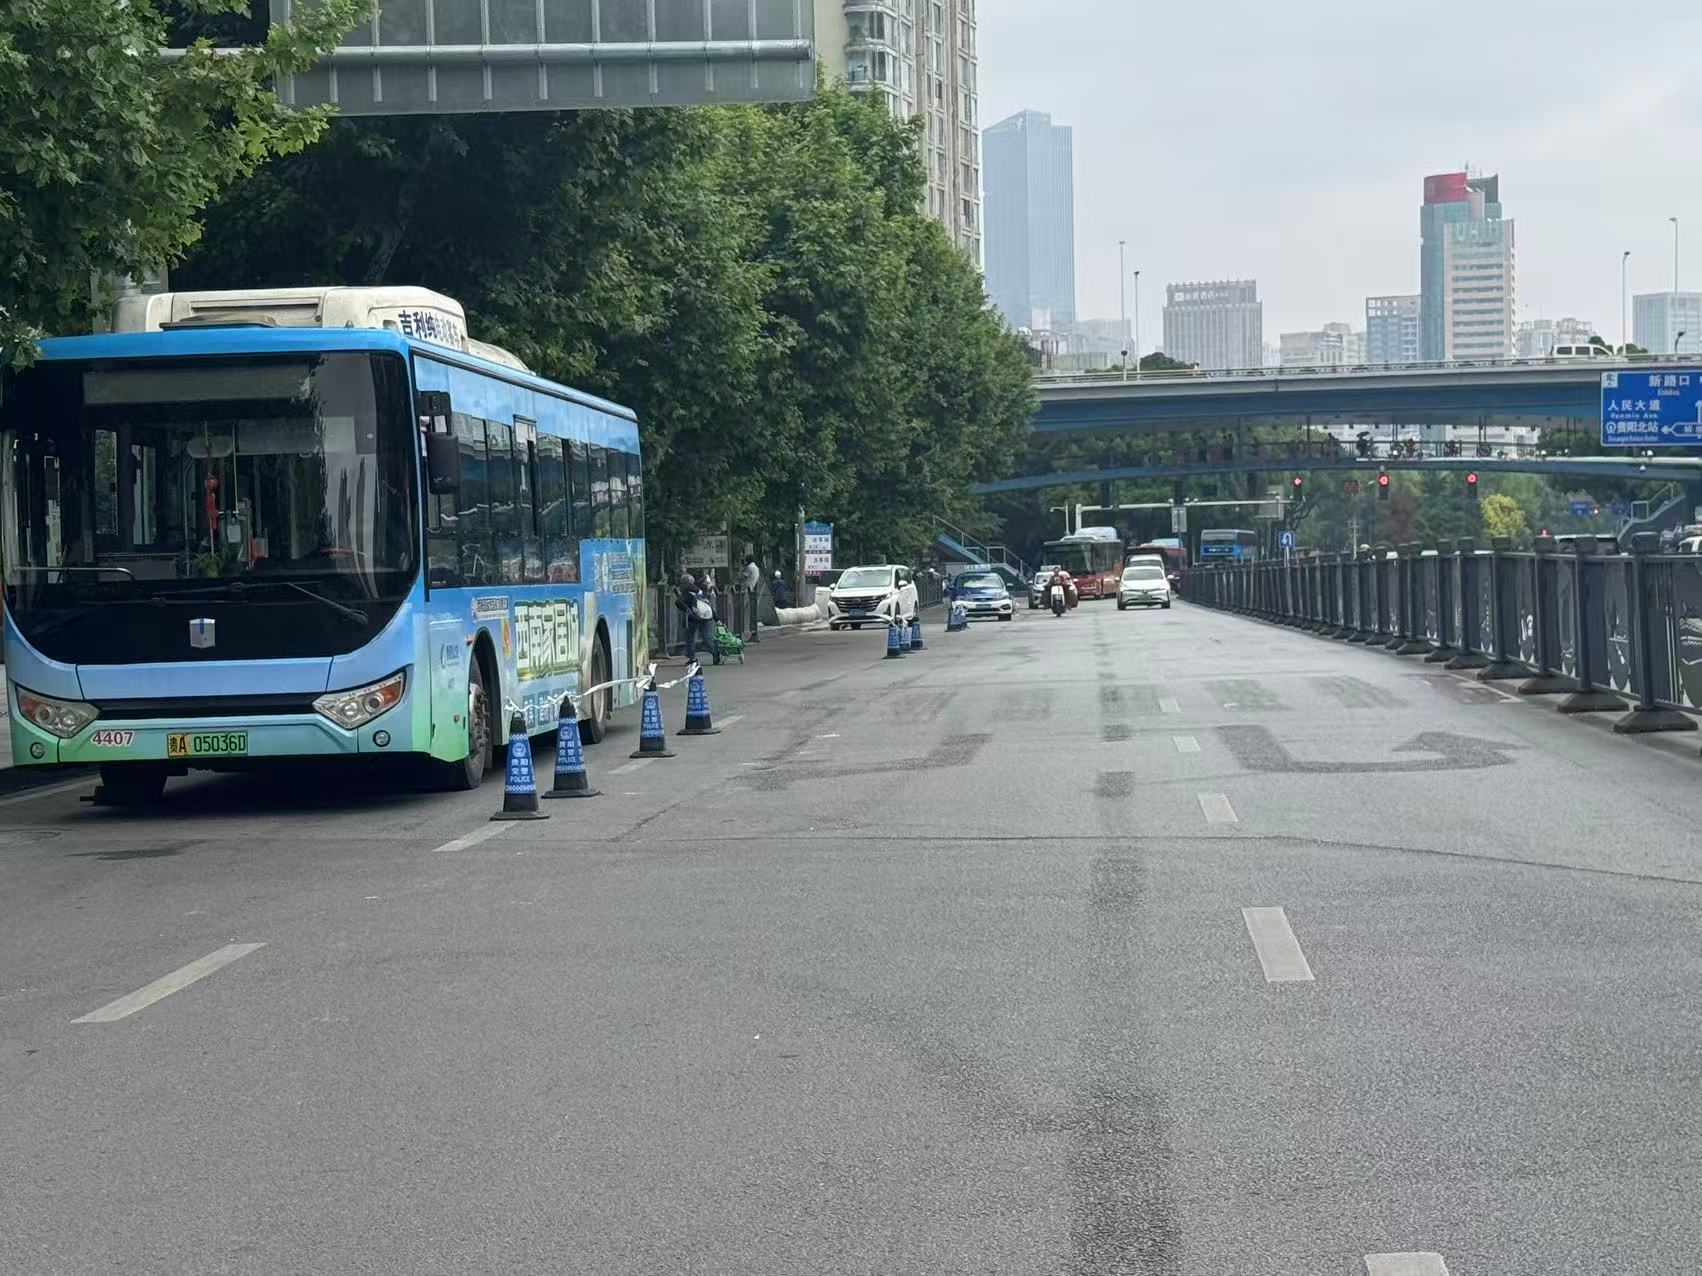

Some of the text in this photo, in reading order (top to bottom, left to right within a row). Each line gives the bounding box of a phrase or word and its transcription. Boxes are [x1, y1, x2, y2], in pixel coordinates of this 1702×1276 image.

[1608, 399, 1660, 411] 人民大道
[1617, 421, 1659, 433] 贵阳北站
[92, 731, 134, 746] 4407
[511, 758, 529, 766] 贵阳
[511, 767, 529, 775] 交警
[510, 775, 530, 783] POLICE
